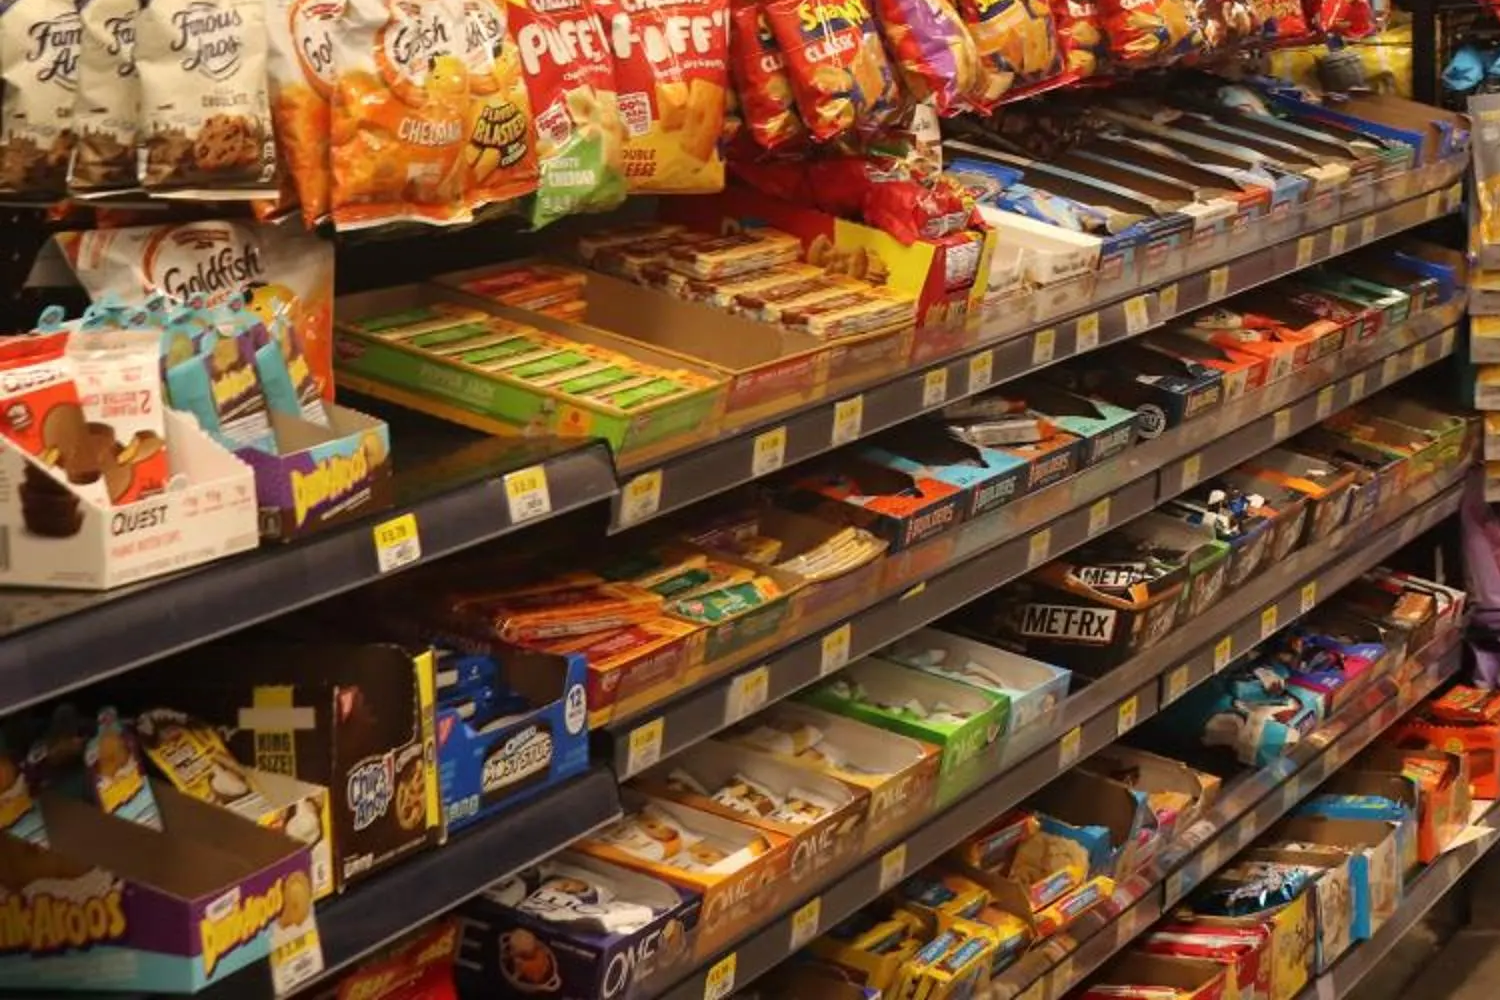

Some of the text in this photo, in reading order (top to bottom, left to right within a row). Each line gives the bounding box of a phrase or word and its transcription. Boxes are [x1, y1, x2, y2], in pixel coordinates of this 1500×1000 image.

[26, 20, 81, 62] Fam
[170, 8, 242, 51] Fmous
[163, 245, 263, 303] Goldfish
[111, 504, 169, 537] QUEST
[569, 688, 582, 708] 12
